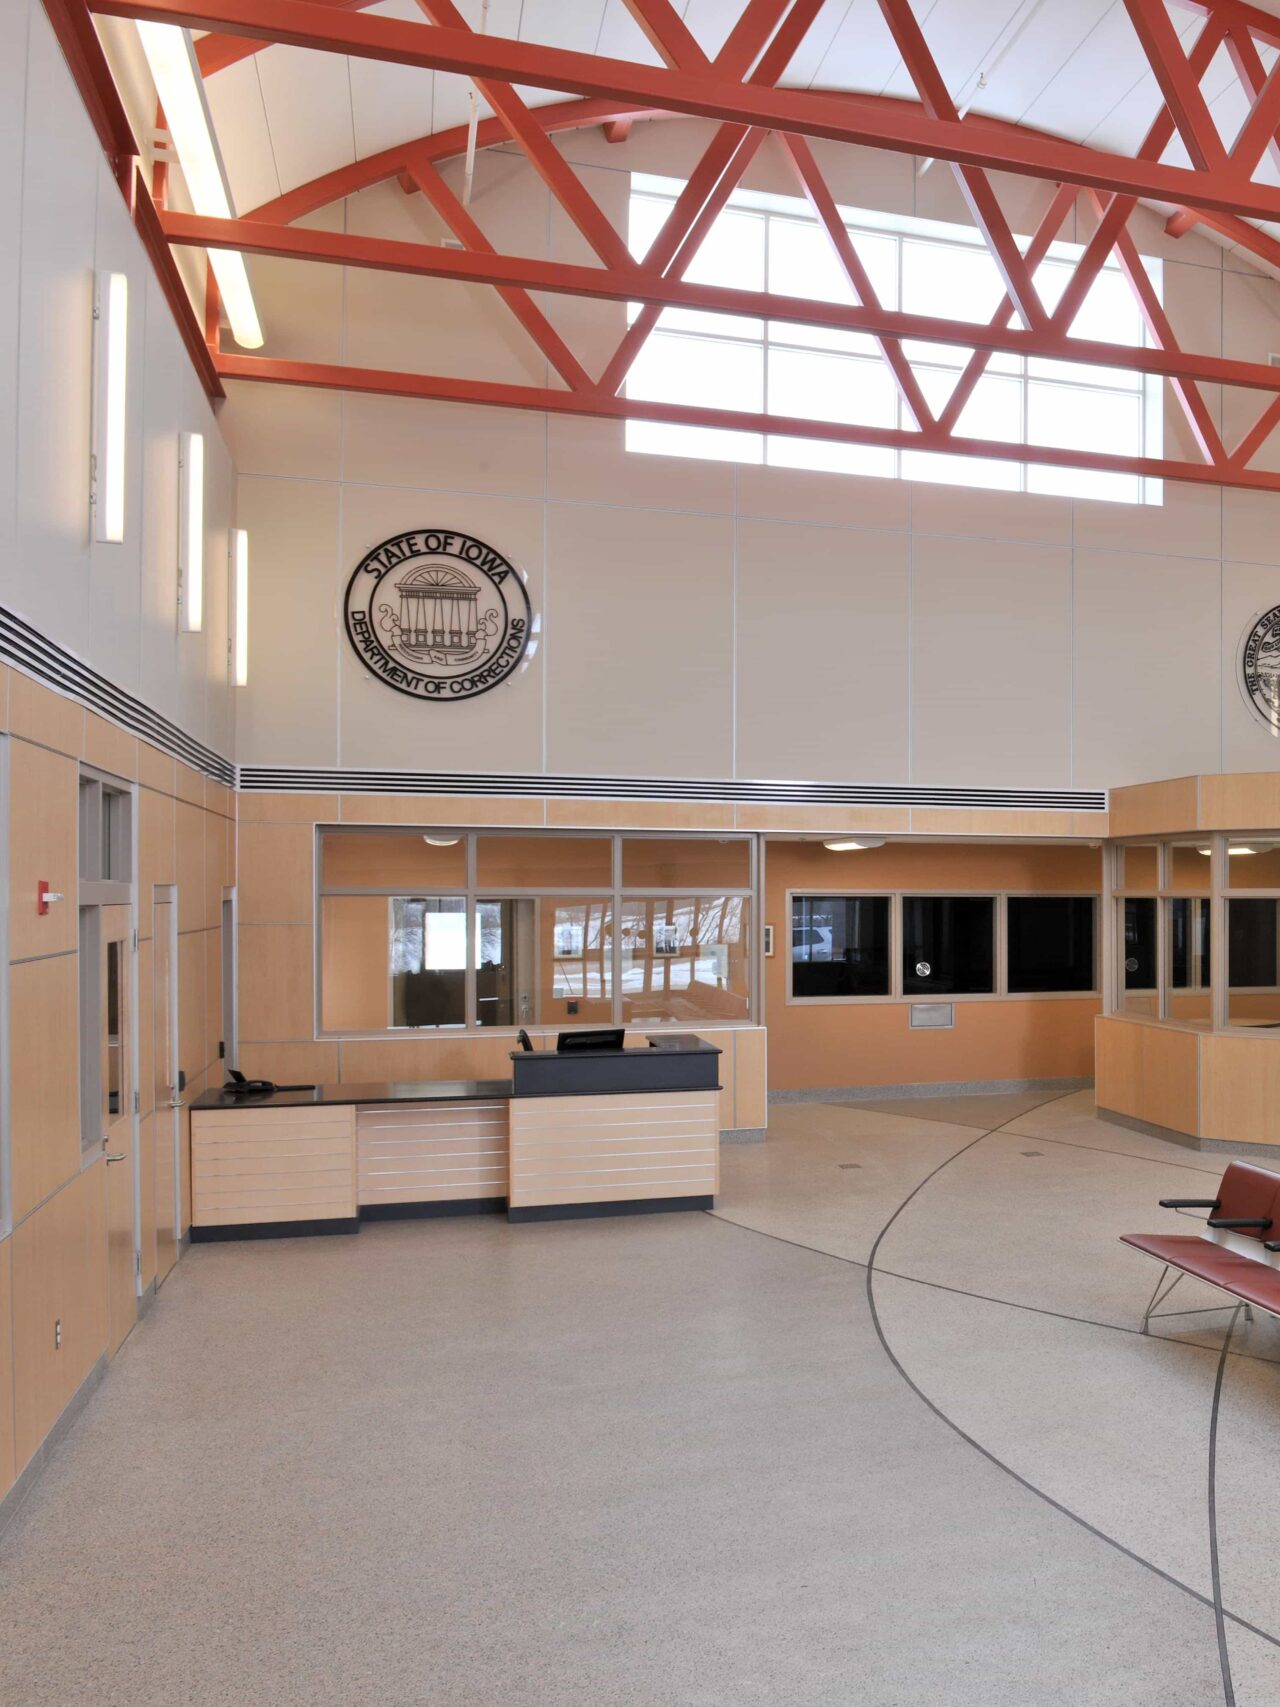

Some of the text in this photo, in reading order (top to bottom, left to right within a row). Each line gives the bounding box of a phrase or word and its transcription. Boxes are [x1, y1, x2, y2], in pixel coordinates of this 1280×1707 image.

[364, 534, 512, 585] STATE OF IOWA
[351, 610, 526, 694] DEPARTMENT OF CORRECTIONS
[1246, 631, 1262, 667] GREAT
[1246, 672, 1259, 695] THE
